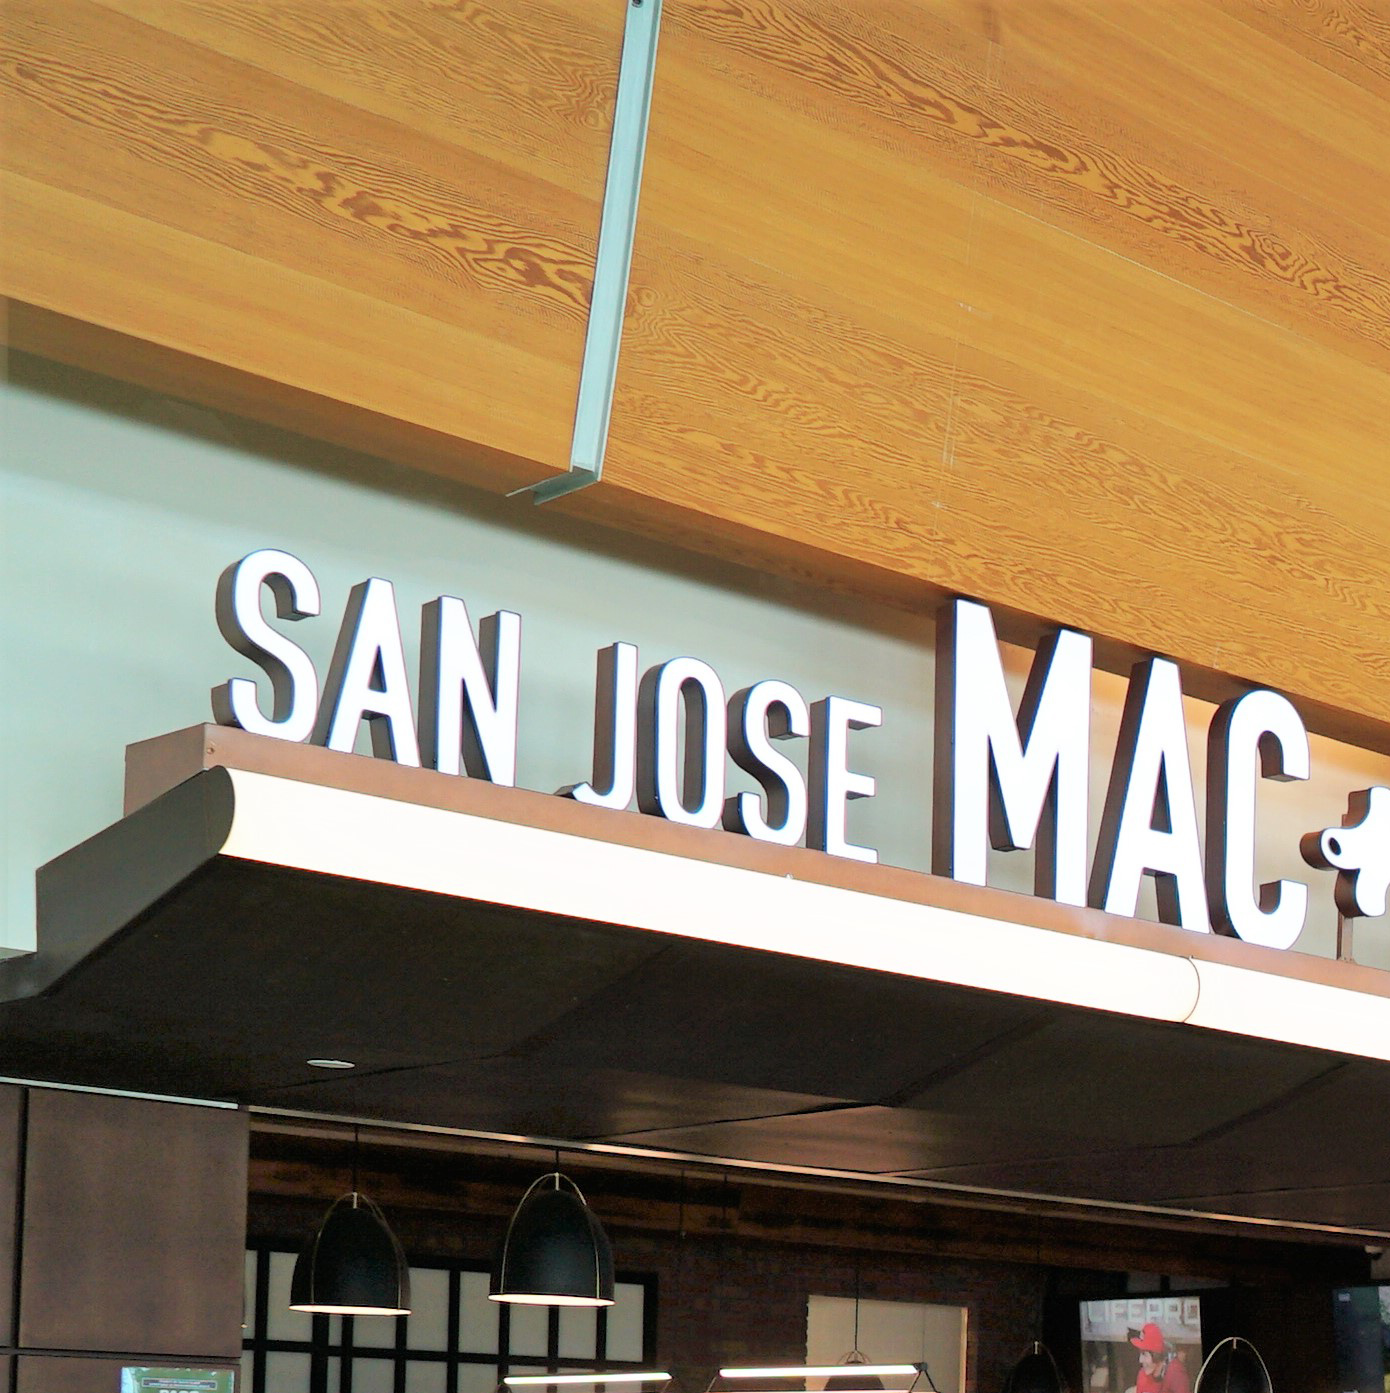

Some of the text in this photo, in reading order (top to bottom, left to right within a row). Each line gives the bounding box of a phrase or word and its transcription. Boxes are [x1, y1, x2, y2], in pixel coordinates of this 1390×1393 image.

[213, 548, 522, 788] SAN
[559, 641, 882, 864] JOSE
[934, 598, 1310, 950] MAC
